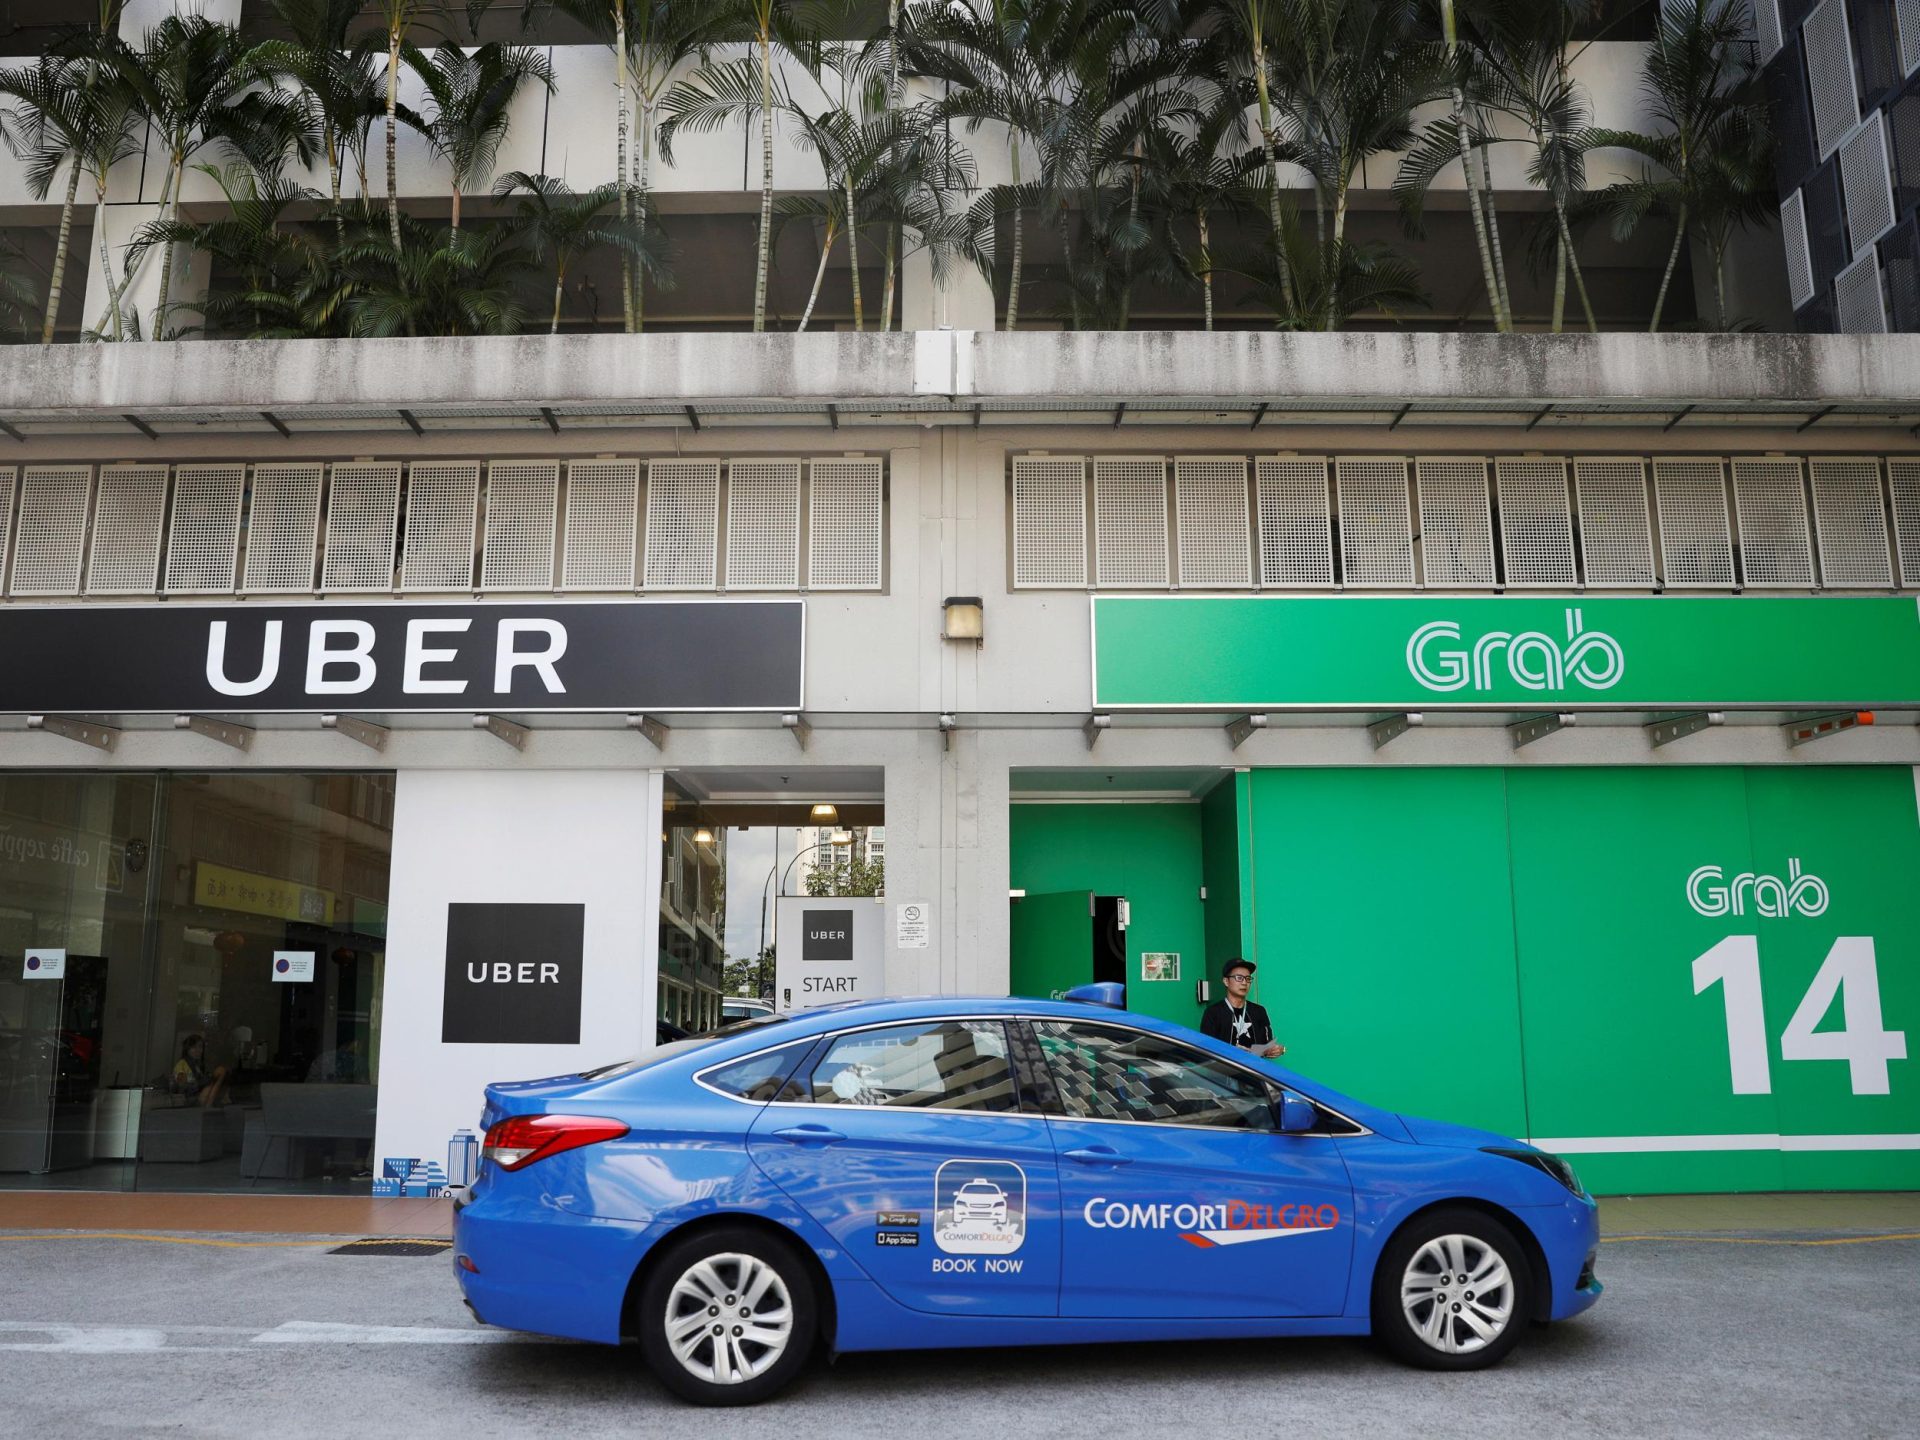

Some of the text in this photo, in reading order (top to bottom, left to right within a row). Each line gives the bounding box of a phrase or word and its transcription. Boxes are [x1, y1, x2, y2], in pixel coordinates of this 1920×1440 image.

[206, 618, 568, 696] UBER
[1406, 608, 1624, 691] Grab
[1686, 858, 1829, 918] Grab
[810, 931, 845, 940] UBER
[467, 962, 559, 983] UBER
[803, 977, 858, 992] START
[1692, 935, 1907, 1095] 14
[886, 1236, 899, 1245] App
[932, 1259, 1023, 1273] BOOK NOW
